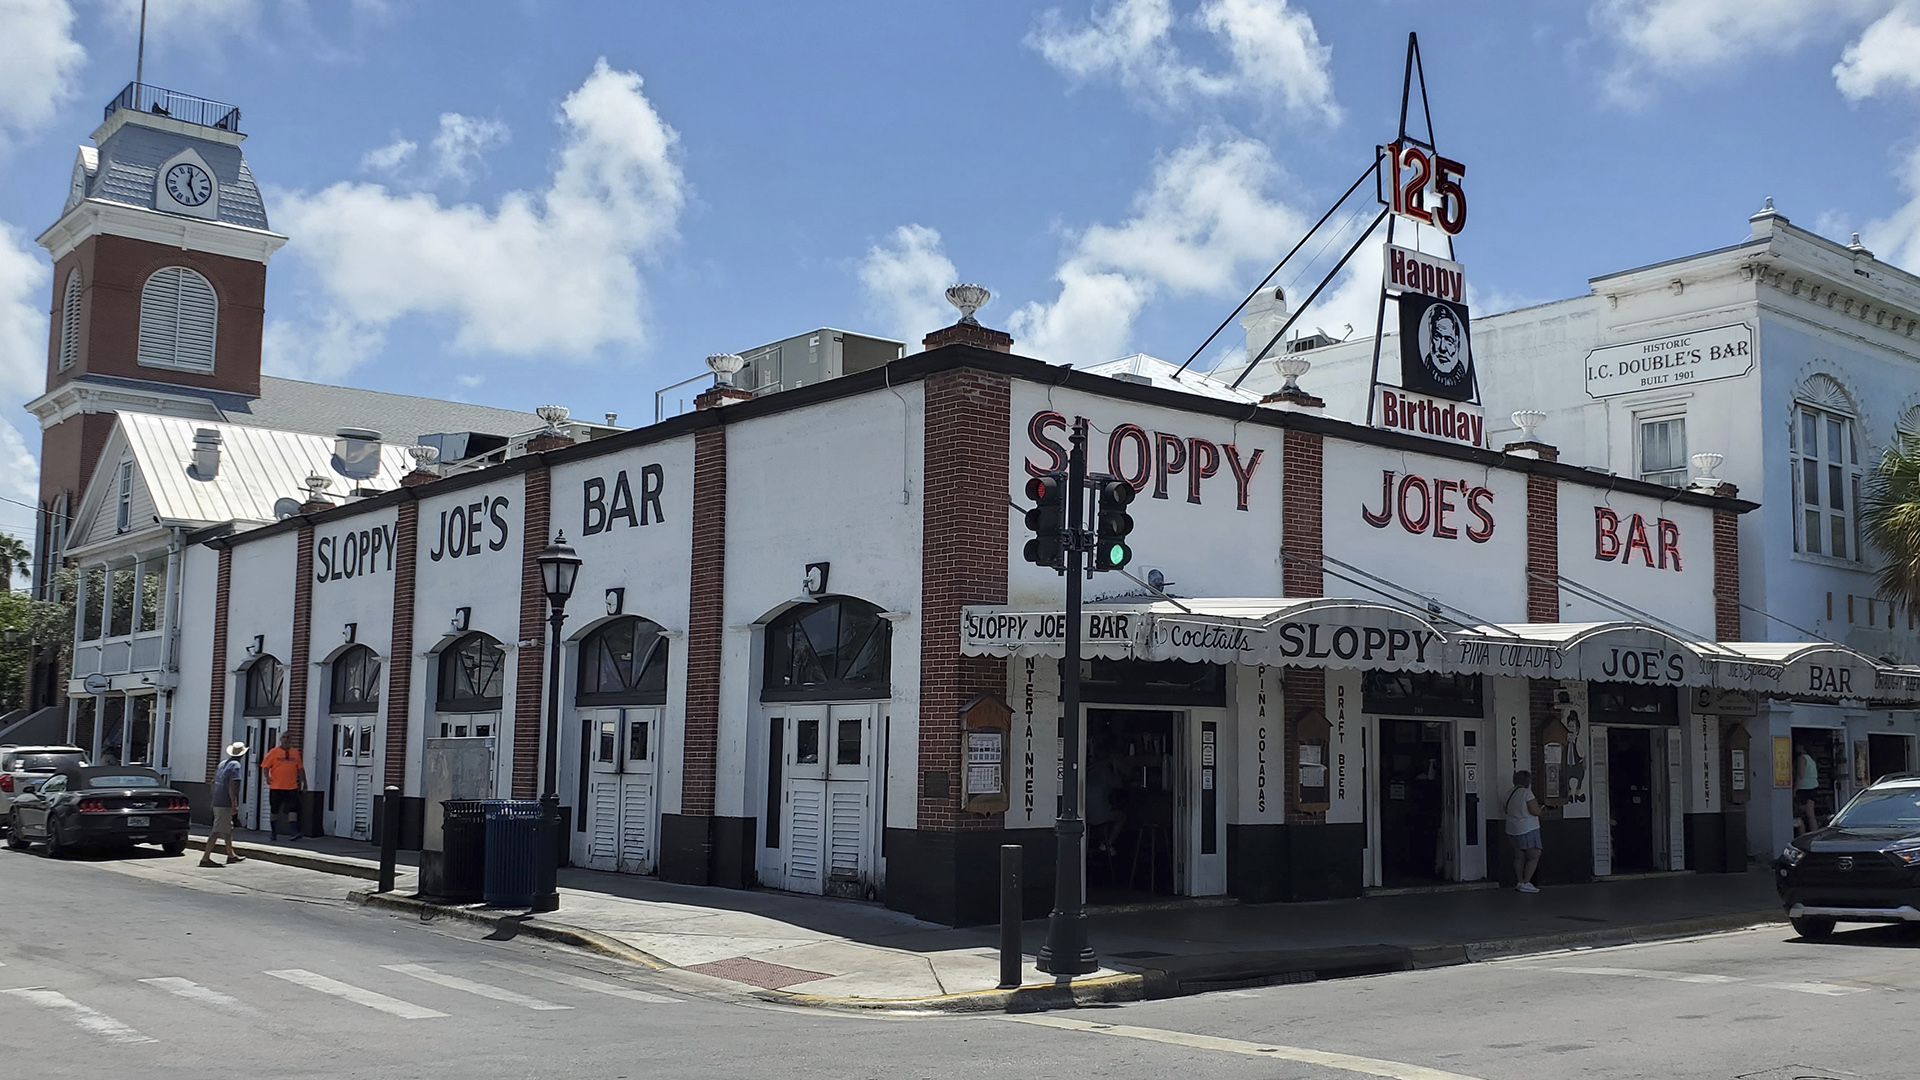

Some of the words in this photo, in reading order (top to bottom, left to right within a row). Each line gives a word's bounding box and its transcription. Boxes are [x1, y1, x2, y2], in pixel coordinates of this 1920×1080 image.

[1386, 142, 1467, 235] 125
[1390, 249, 1462, 303] Happy
[1588, 365, 1613, 381] I.C.
[1618, 349, 1701, 376] DOUBLE'S
[1709, 340, 1749, 361] BAR
[1643, 338, 1691, 353] HISTORIC
[1640, 374, 1669, 387] BUILT
[1674, 370, 1695, 381] 1901
[1383, 391, 1483, 447] Birthday
[316, 520, 399, 583] SLOPPY
[430, 495, 510, 562] JOE'S
[582, 463, 665, 537] BAR
[1362, 470, 1494, 543] JOE'S
[1594, 506, 1683, 572] BAR
[968, 615, 1028, 640] SLOPPY
[1089, 615, 1129, 639] BAR
[1171, 625, 1256, 650] Cocktails
[1279, 623, 1434, 663] SLOPPY
[1602, 648, 1685, 683] JOE'S
[1808, 665, 1853, 693] BAR
[1025, 656, 1035, 822] NTERTAINMENT
[1258, 727, 1266, 813] COLADAS
